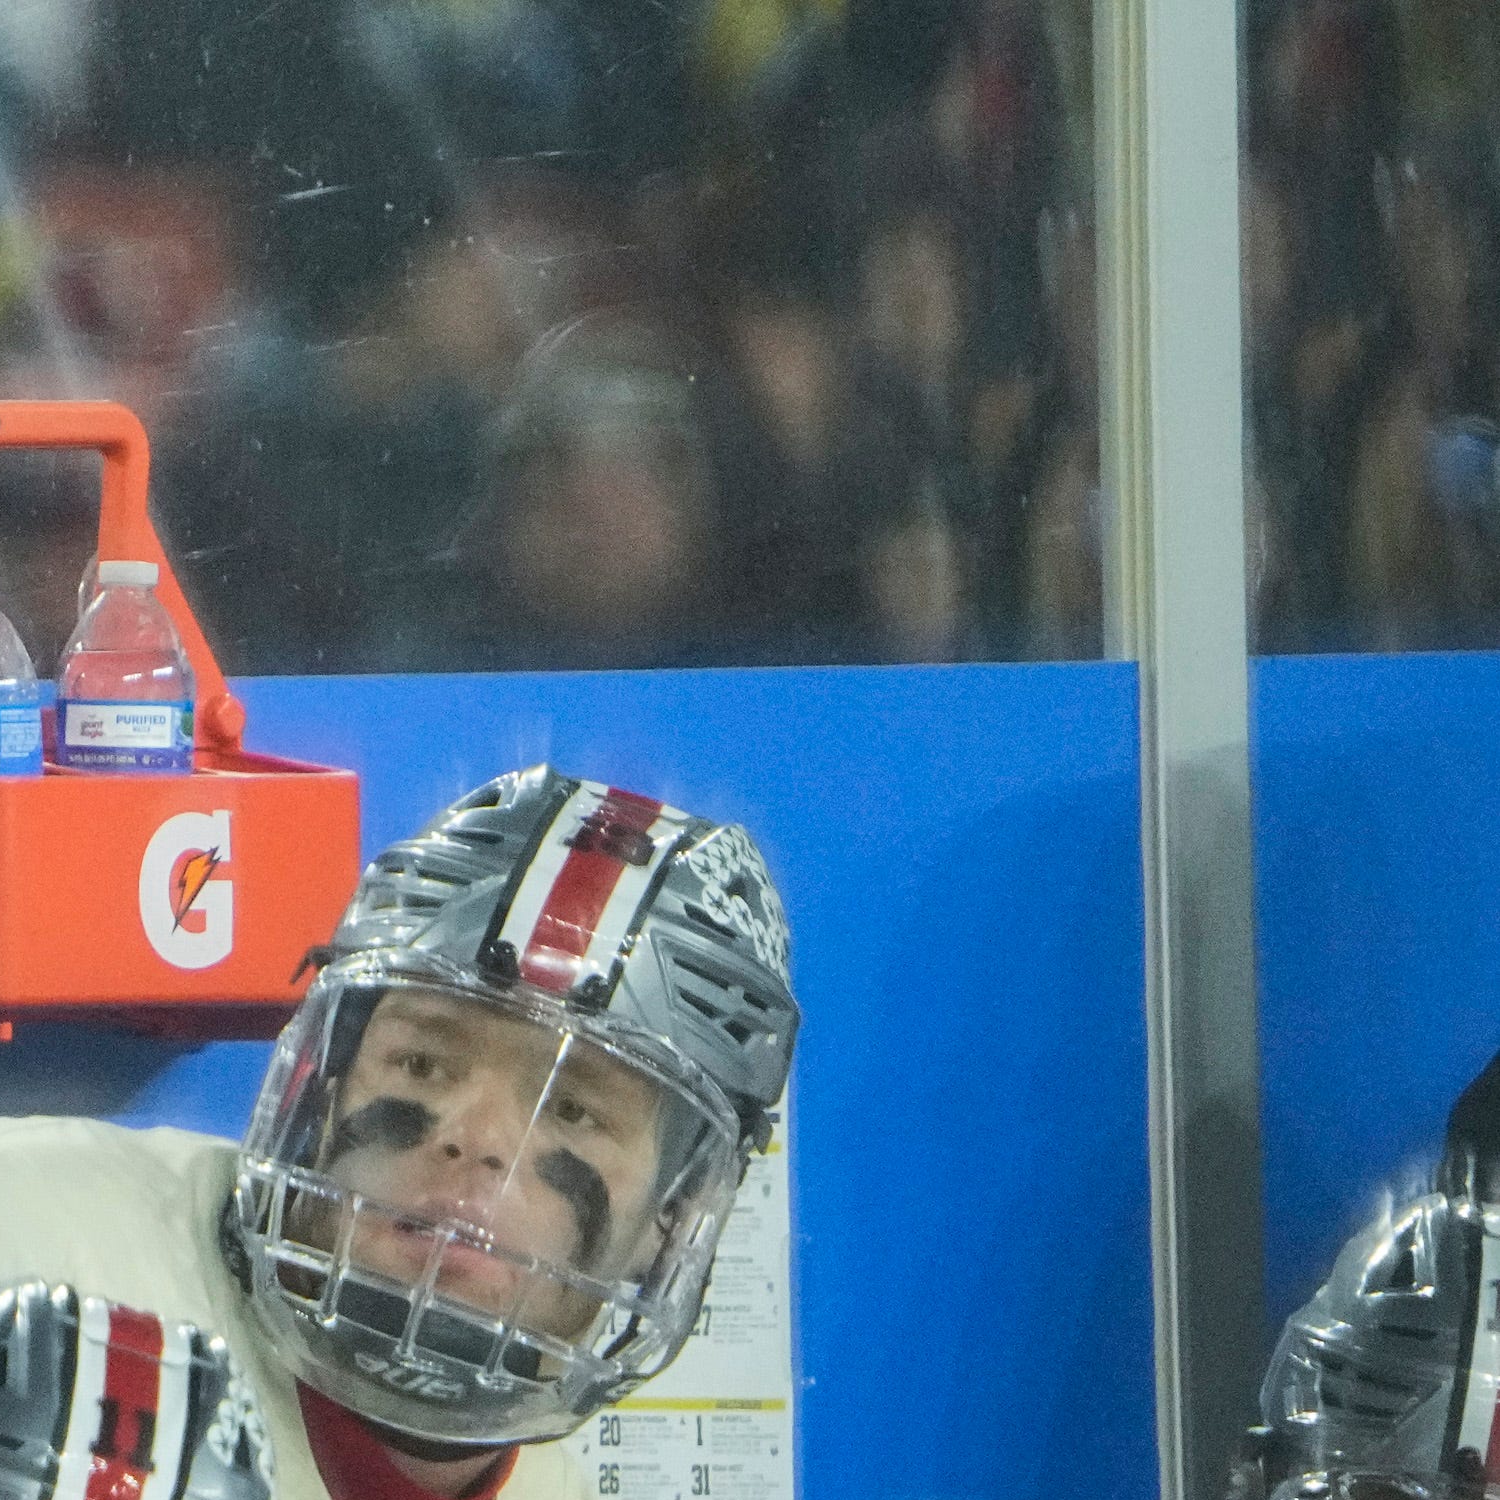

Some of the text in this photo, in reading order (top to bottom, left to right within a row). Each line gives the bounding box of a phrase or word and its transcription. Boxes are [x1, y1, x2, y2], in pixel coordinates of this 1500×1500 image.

[115, 714, 166, 725] PURIFIED
[138, 810, 233, 969] G
[600, 1416, 621, 1446] 20
[696, 1416, 703, 1446] 1
[600, 1464, 620, 1494] 26
[691, 1464, 710, 1496] 31
